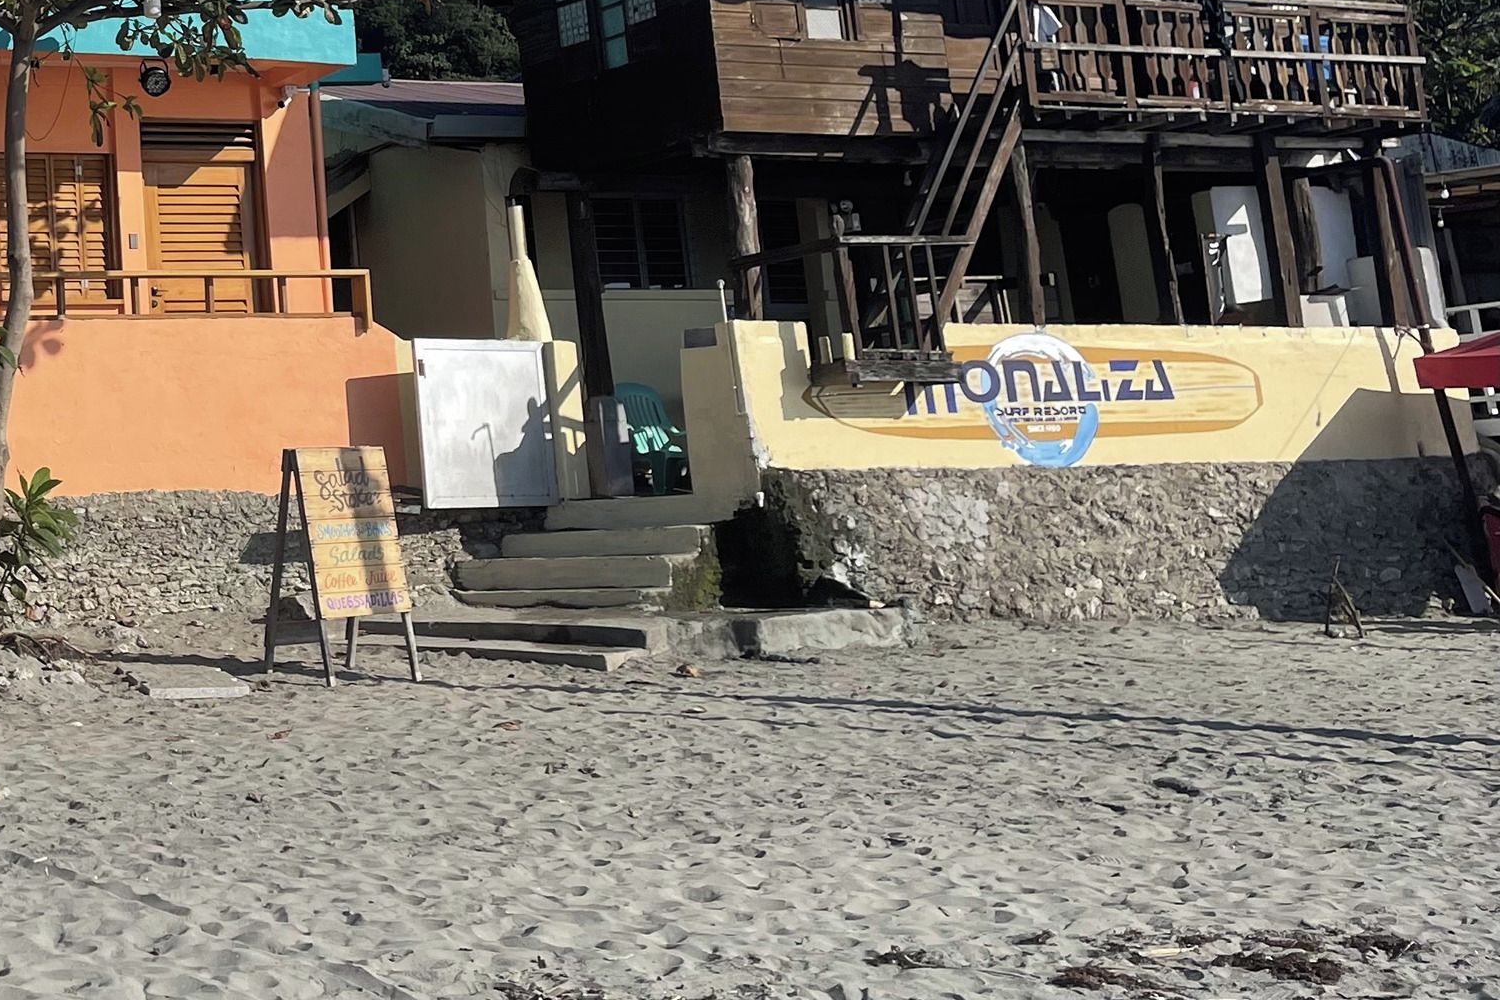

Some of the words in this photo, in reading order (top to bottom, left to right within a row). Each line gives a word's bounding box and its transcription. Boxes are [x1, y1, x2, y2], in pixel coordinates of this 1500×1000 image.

[995, 407, 1030, 416] SURF
[313, 455, 370, 500] Salad
[329, 544, 385, 567] Salads
[324, 572, 357, 590] Coffee
